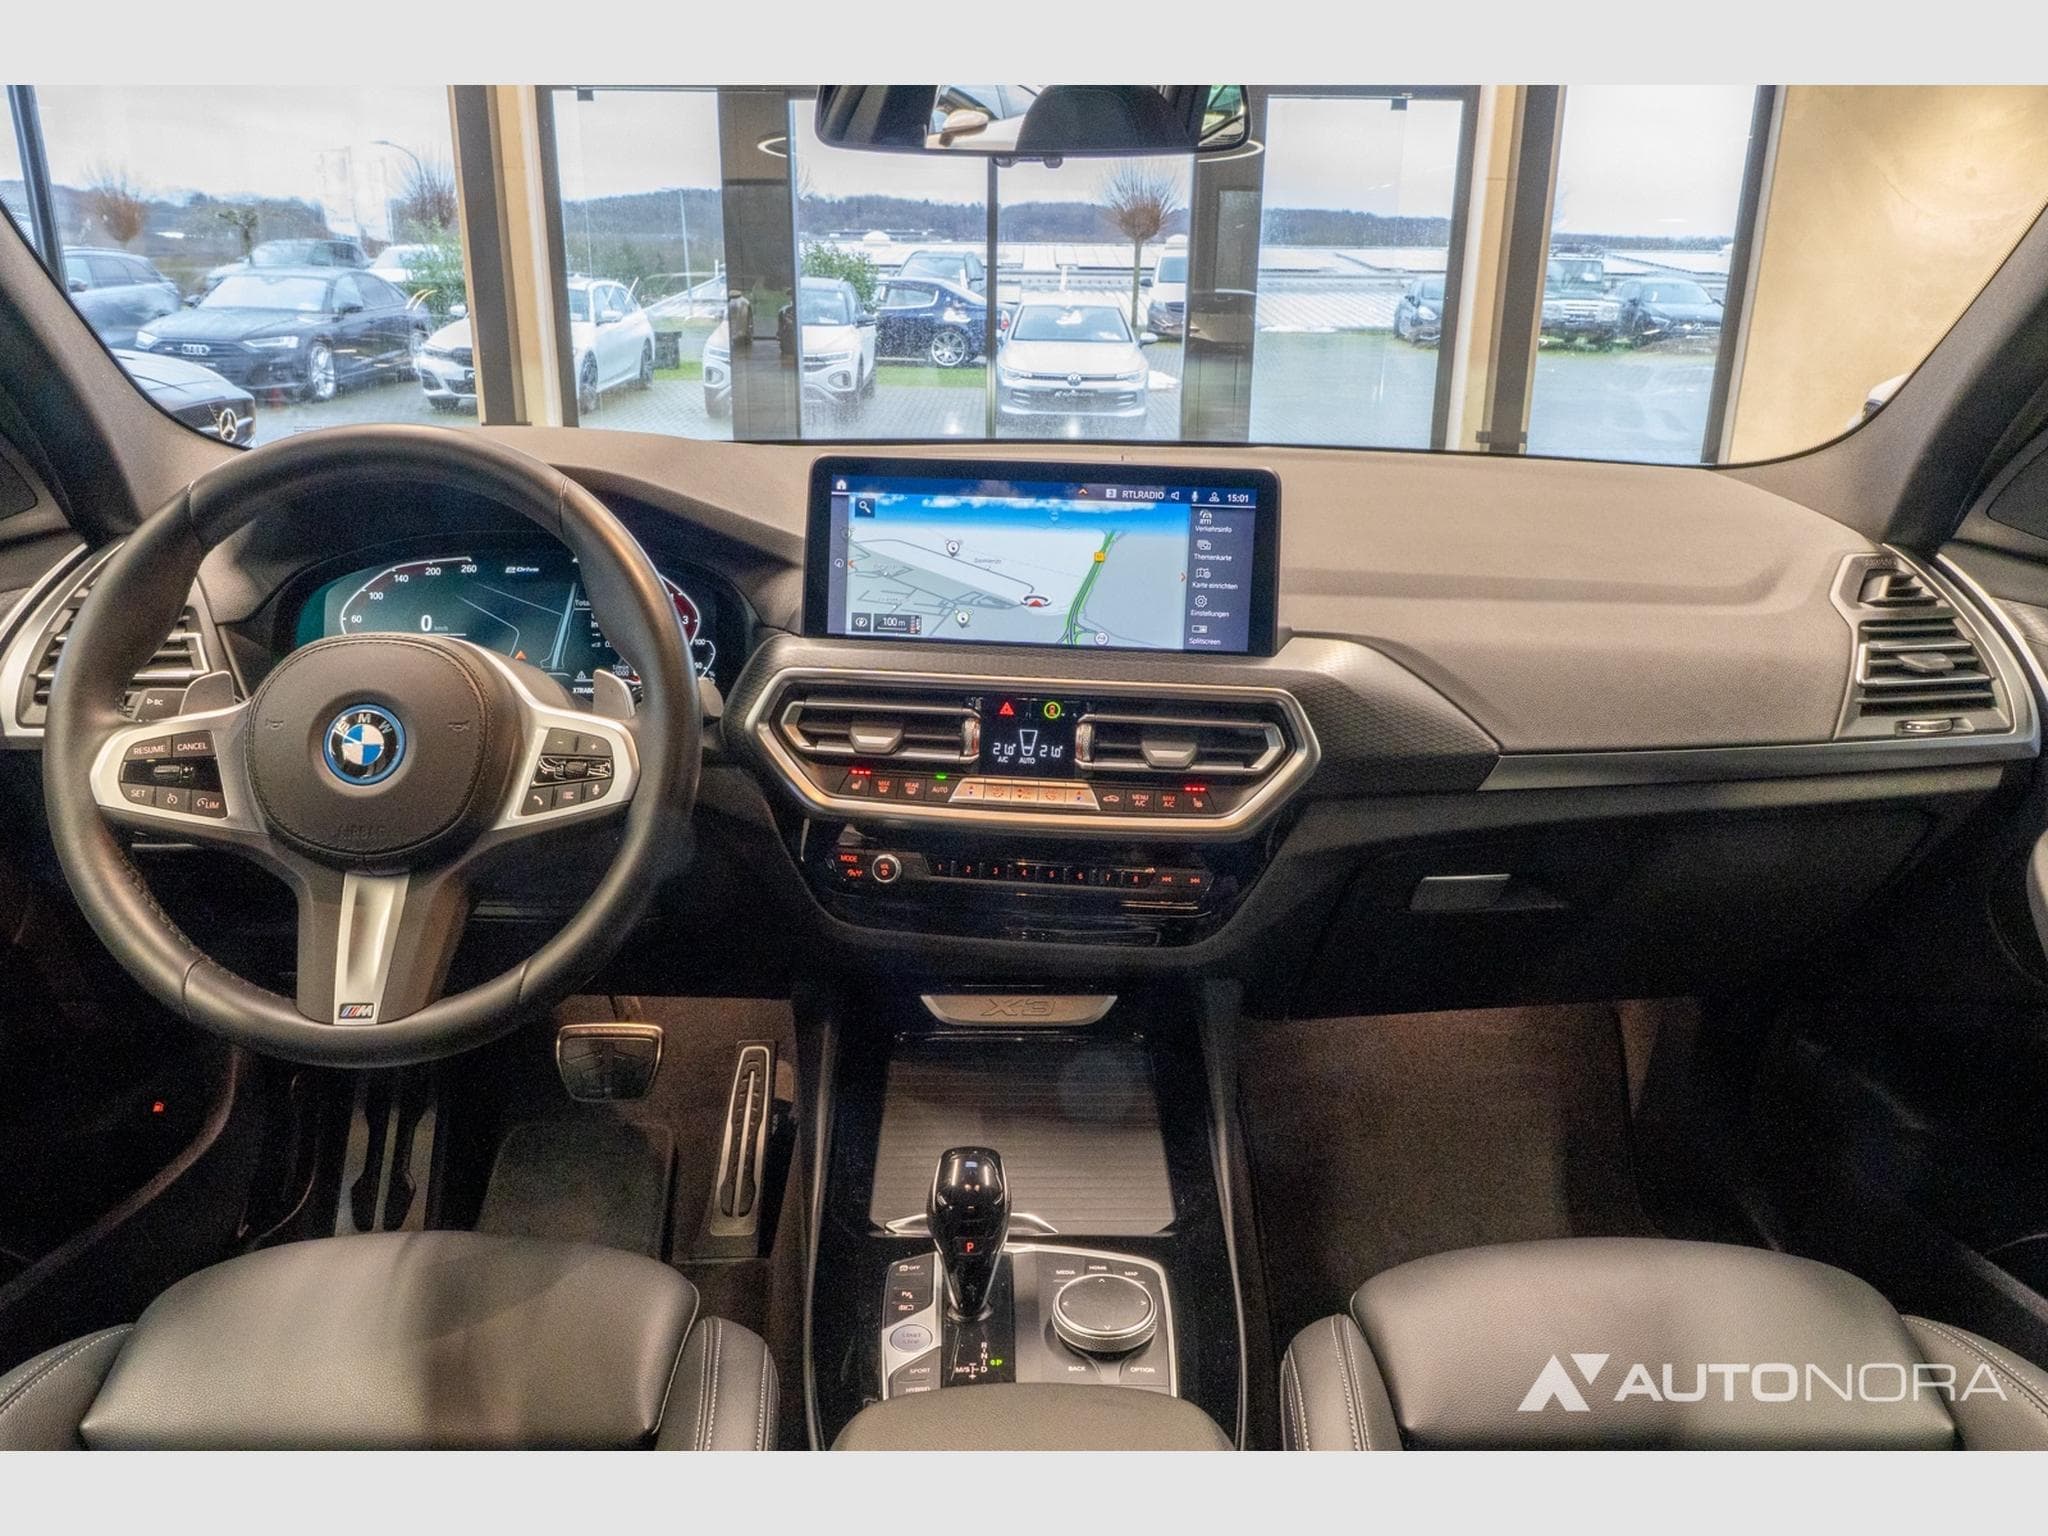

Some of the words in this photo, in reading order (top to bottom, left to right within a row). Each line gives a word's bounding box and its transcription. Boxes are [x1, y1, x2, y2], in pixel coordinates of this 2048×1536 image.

[1227, 494, 1249, 503] 15:01
[1195, 525, 1233, 534] Verkehrsinfo
[1194, 553, 1232, 562] Themenkarte
[425, 567, 441, 576] 200
[461, 564, 477, 573] 260
[394, 574, 409, 583] 140
[1192, 581, 1208, 589] Karte
[369, 592, 384, 601] 100
[1190, 609, 1230, 618] Einstellungen
[351, 614, 362, 624] 60
[421, 615, 432, 632] 0
[682, 615, 689, 624] 3
[882, 617, 898, 626] 100
[1188, 637, 1221, 645] Splitscreen
[133, 744, 166, 755] RESUME
[177, 741, 208, 751] CANCEL
[130, 789, 146, 797] SET
[931, 786, 949, 794] AUTO
[205, 801, 220, 809] LIM
[840, 854, 858, 862] MODE
[980, 998, 1057, 1017] X3
[966, 1242, 974, 1252] P
